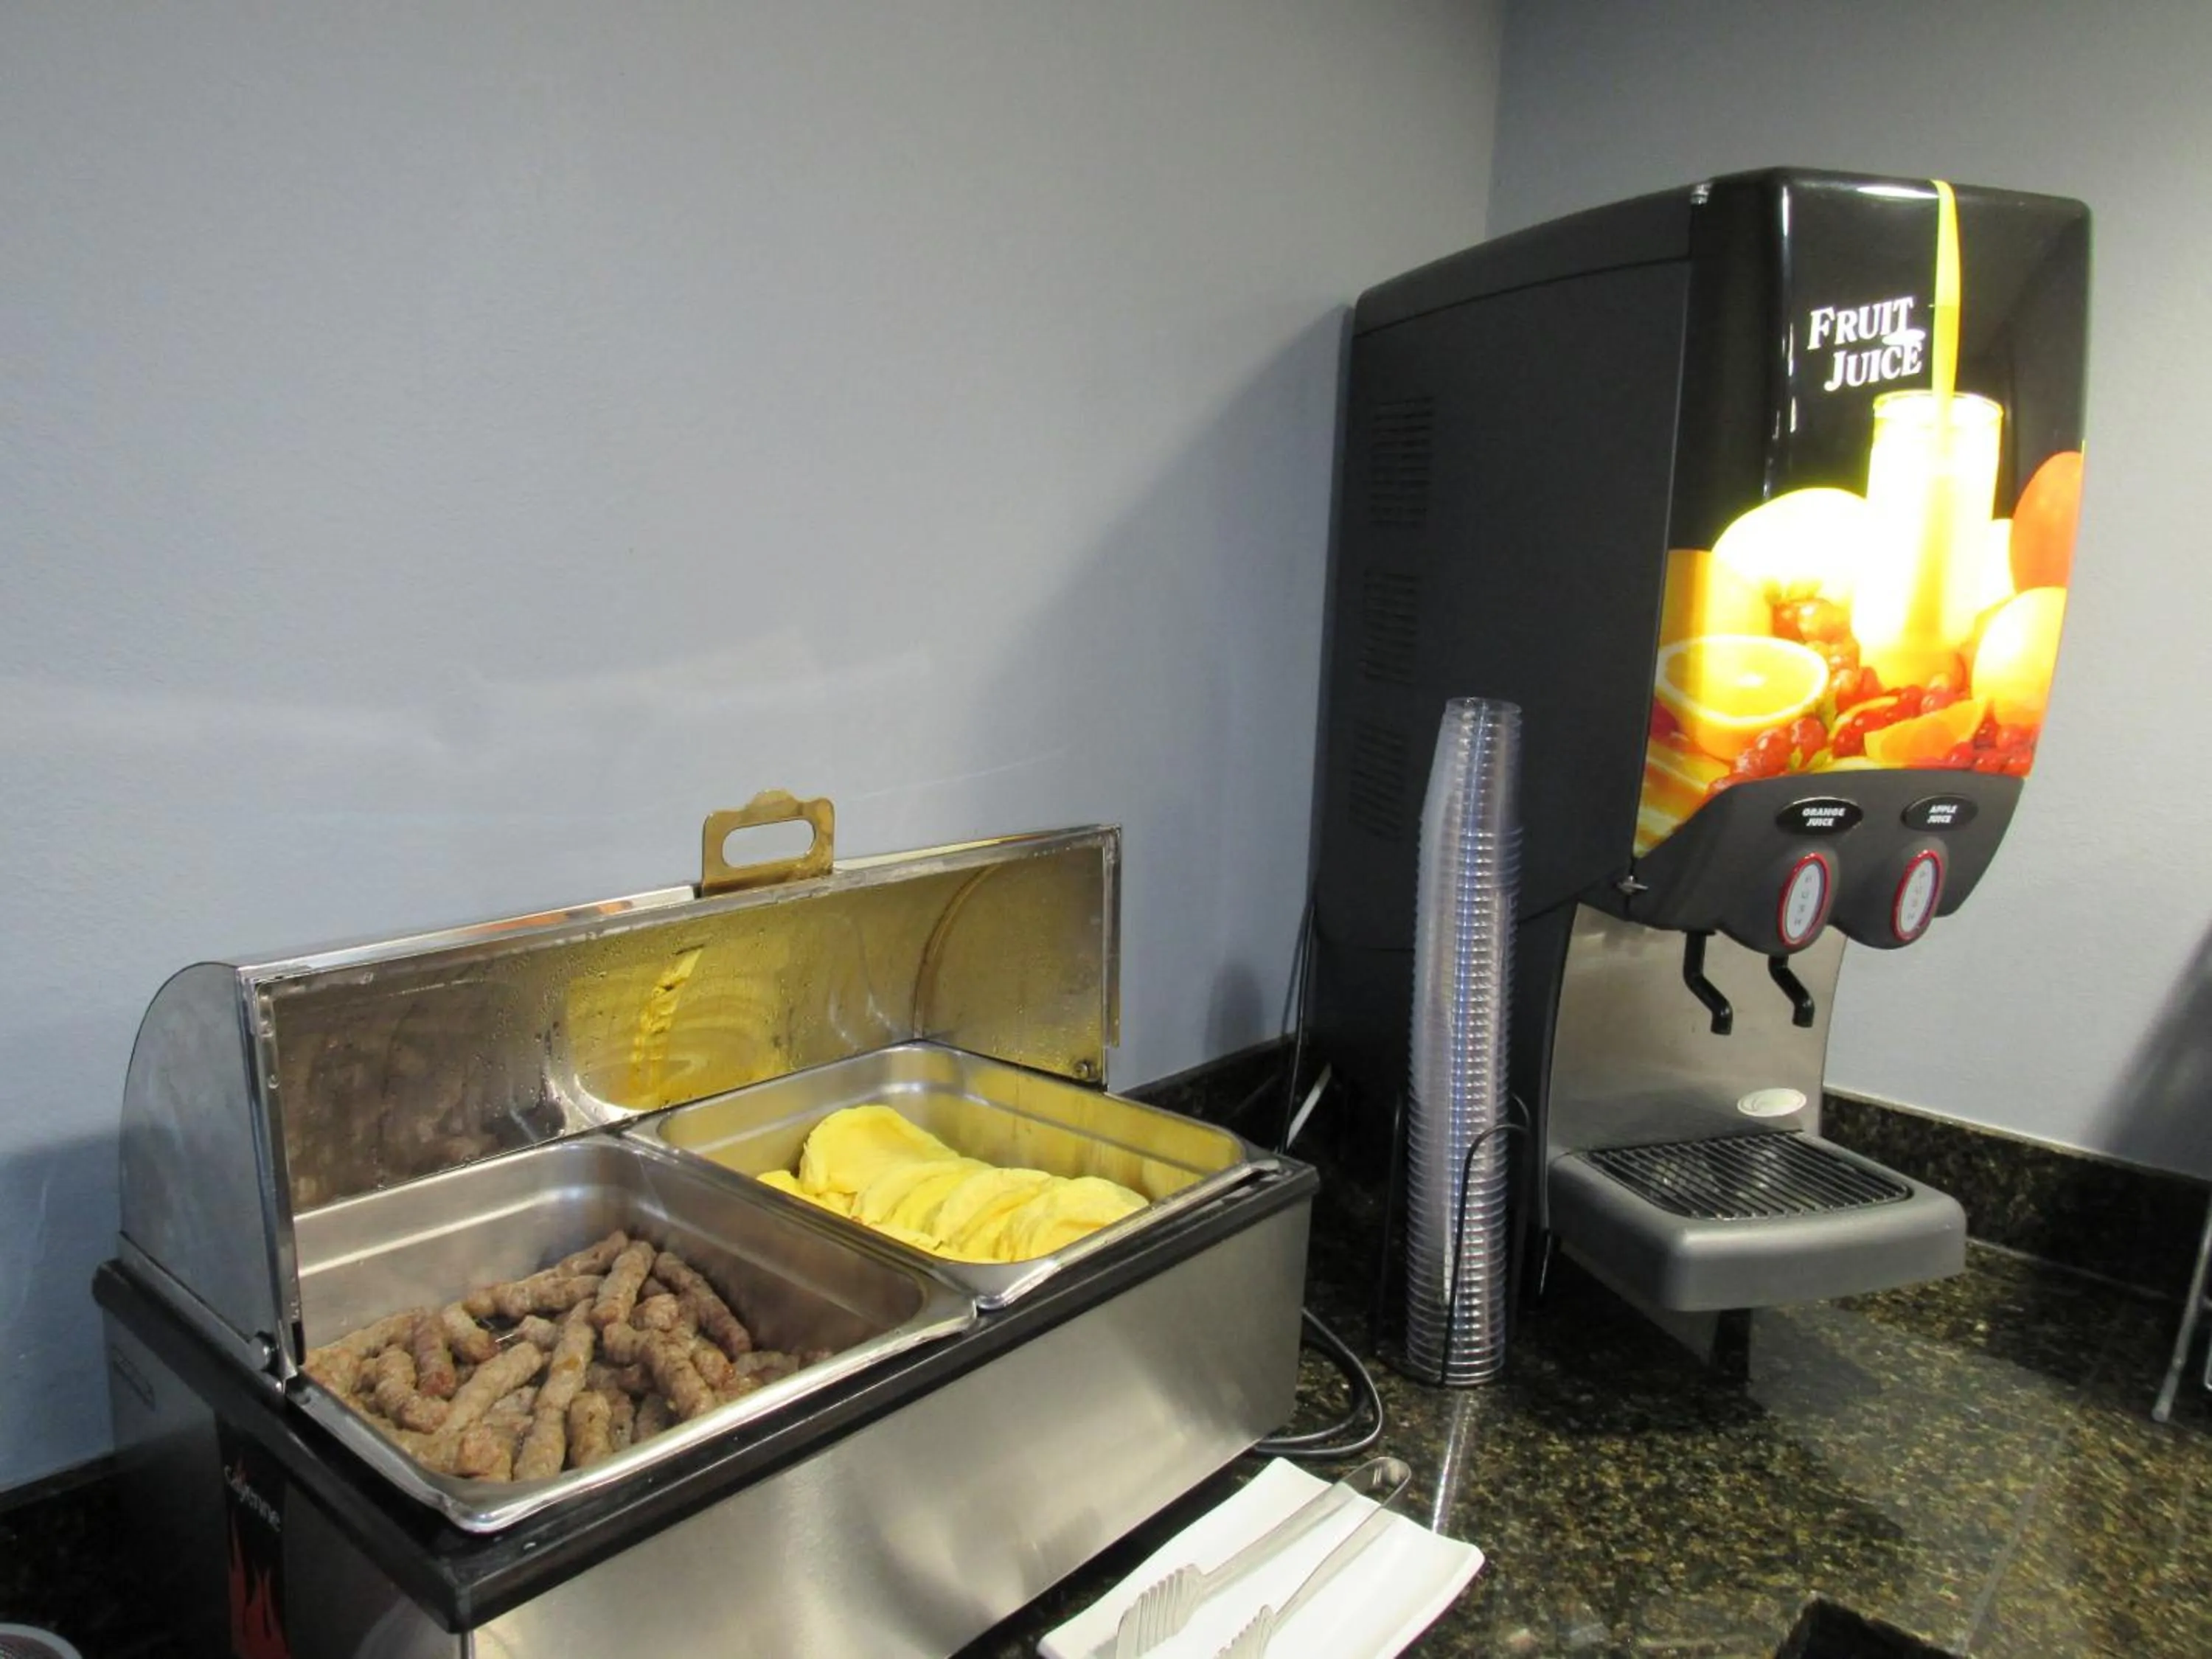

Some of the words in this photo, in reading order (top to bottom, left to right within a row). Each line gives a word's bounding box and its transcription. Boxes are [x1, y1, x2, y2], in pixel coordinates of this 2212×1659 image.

[1807, 296, 1914, 350] FRUIT
[1823, 340, 1923, 392] JUICE
[1802, 807, 1846, 816] ORANGE
[1928, 804, 1958, 813] APPLE
[1806, 818, 1834, 827] JUICE
[1927, 815, 1952, 824] JUICE
